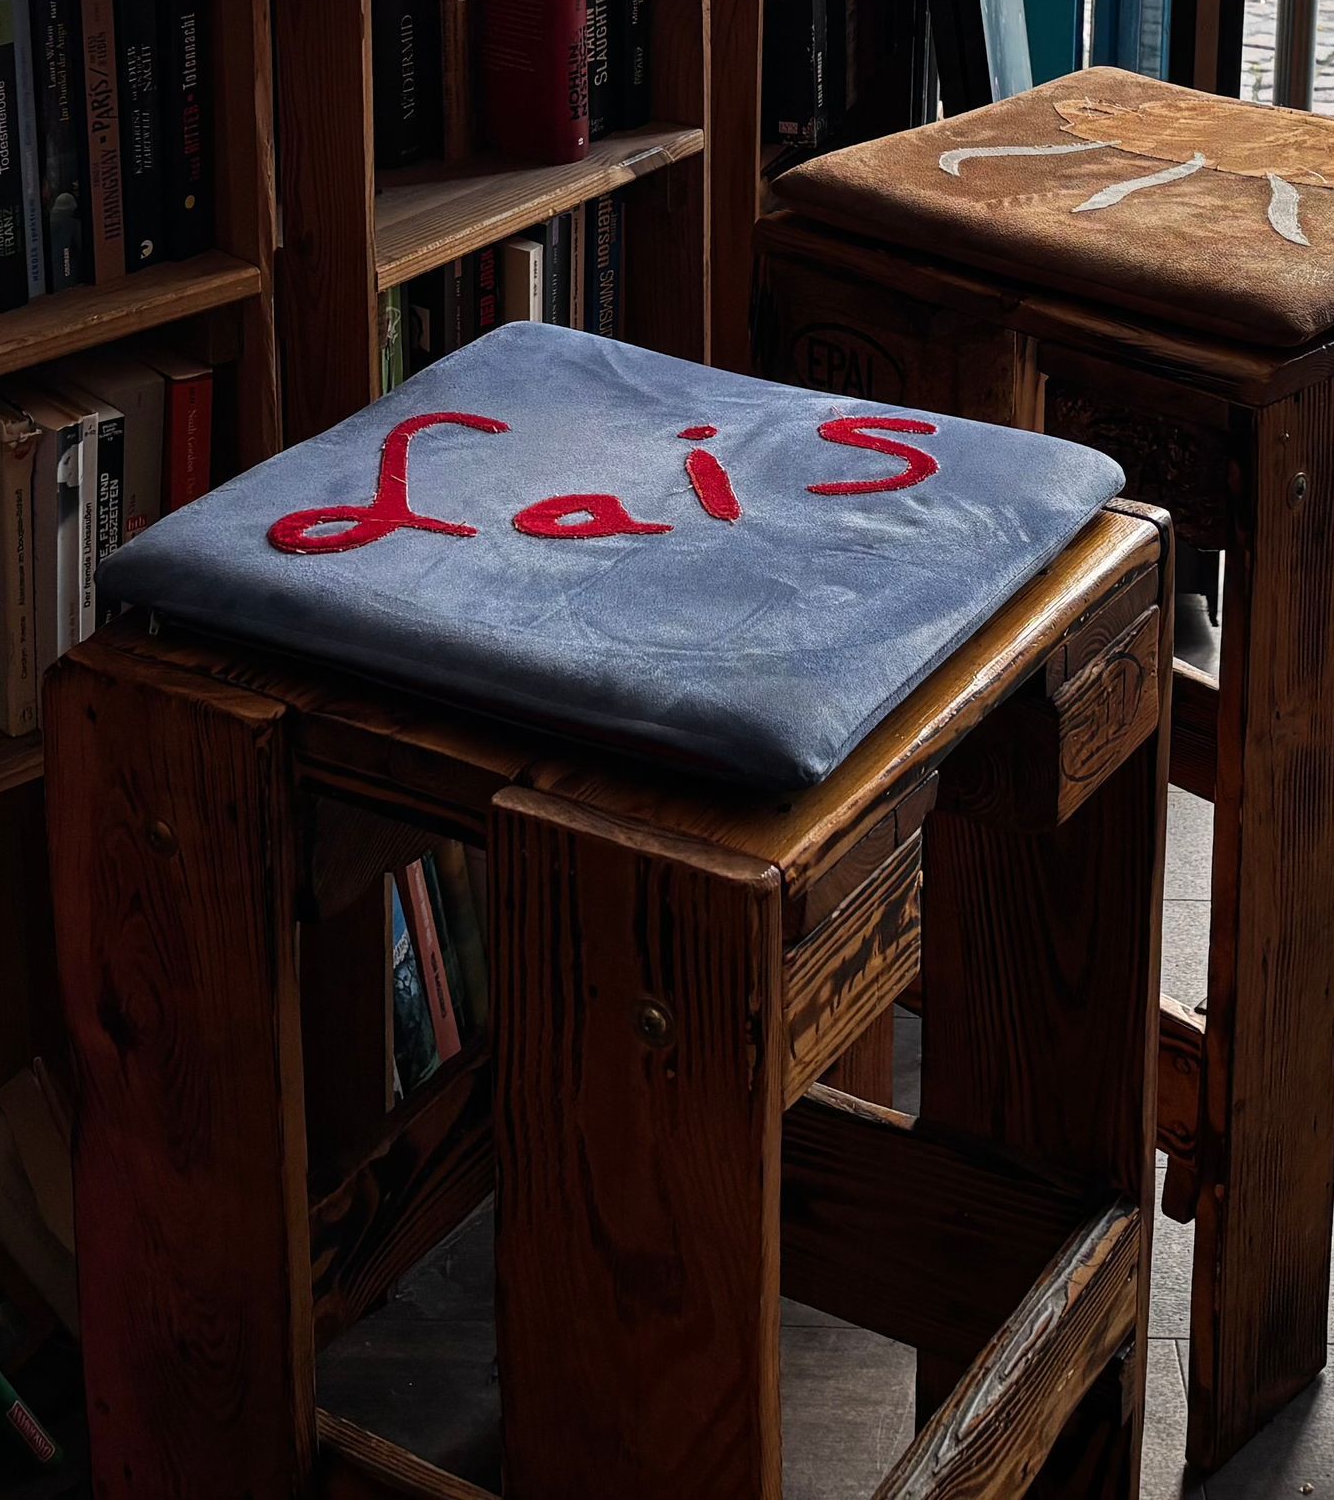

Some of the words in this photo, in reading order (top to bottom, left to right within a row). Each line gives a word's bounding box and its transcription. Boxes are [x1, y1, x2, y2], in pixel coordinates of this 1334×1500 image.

[44, 24, 56, 61] Wilson
[179, 12, 199, 91] Totennacht
[57, 52, 68, 70] der
[58, 70, 70, 106] Dunkel
[568, 44, 580, 121] MOHLIN
[100, 149, 121, 241] HEMINGWAY
[187, 409, 198, 435] Noah
[187, 437, 197, 473] Gordon
[100, 472, 109, 503] UND
[81, 502, 92, 555] Linksaußen
[98, 505, 110, 542] FLUT
[82, 556, 92, 589] fremde
[83, 590, 92, 607] Der
